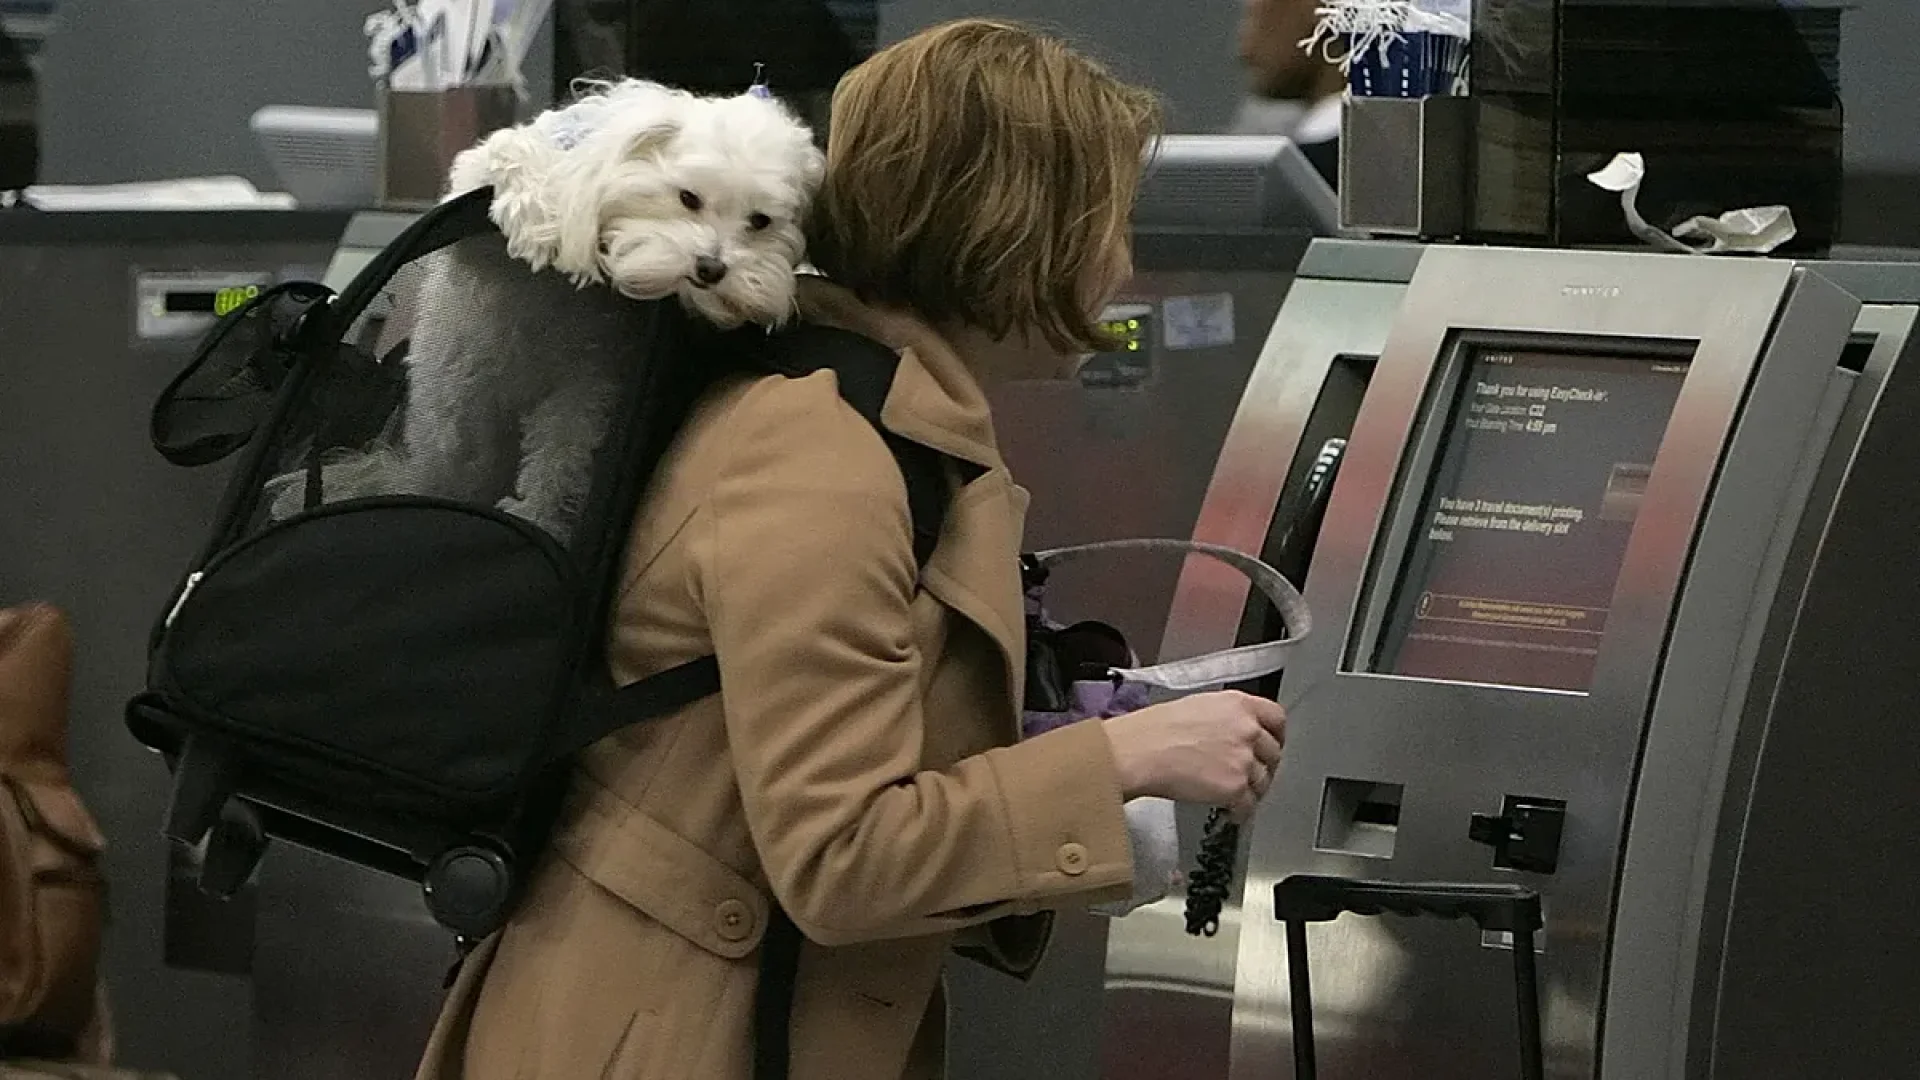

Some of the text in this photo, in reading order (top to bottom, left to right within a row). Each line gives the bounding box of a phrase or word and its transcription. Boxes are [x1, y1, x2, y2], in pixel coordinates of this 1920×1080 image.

[1476, 382, 1500, 395] Thank
[1499, 386, 1516, 399] you
[1516, 385, 1528, 396] for
[1527, 388, 1550, 401] using
[1542, 423, 1558, 435] pm
[1439, 497, 1456, 510] You
[1455, 499, 1475, 511] have
[1480, 500, 1505, 513] travel
[1433, 512, 1571, 536] Please retrieve from the delivery slot
